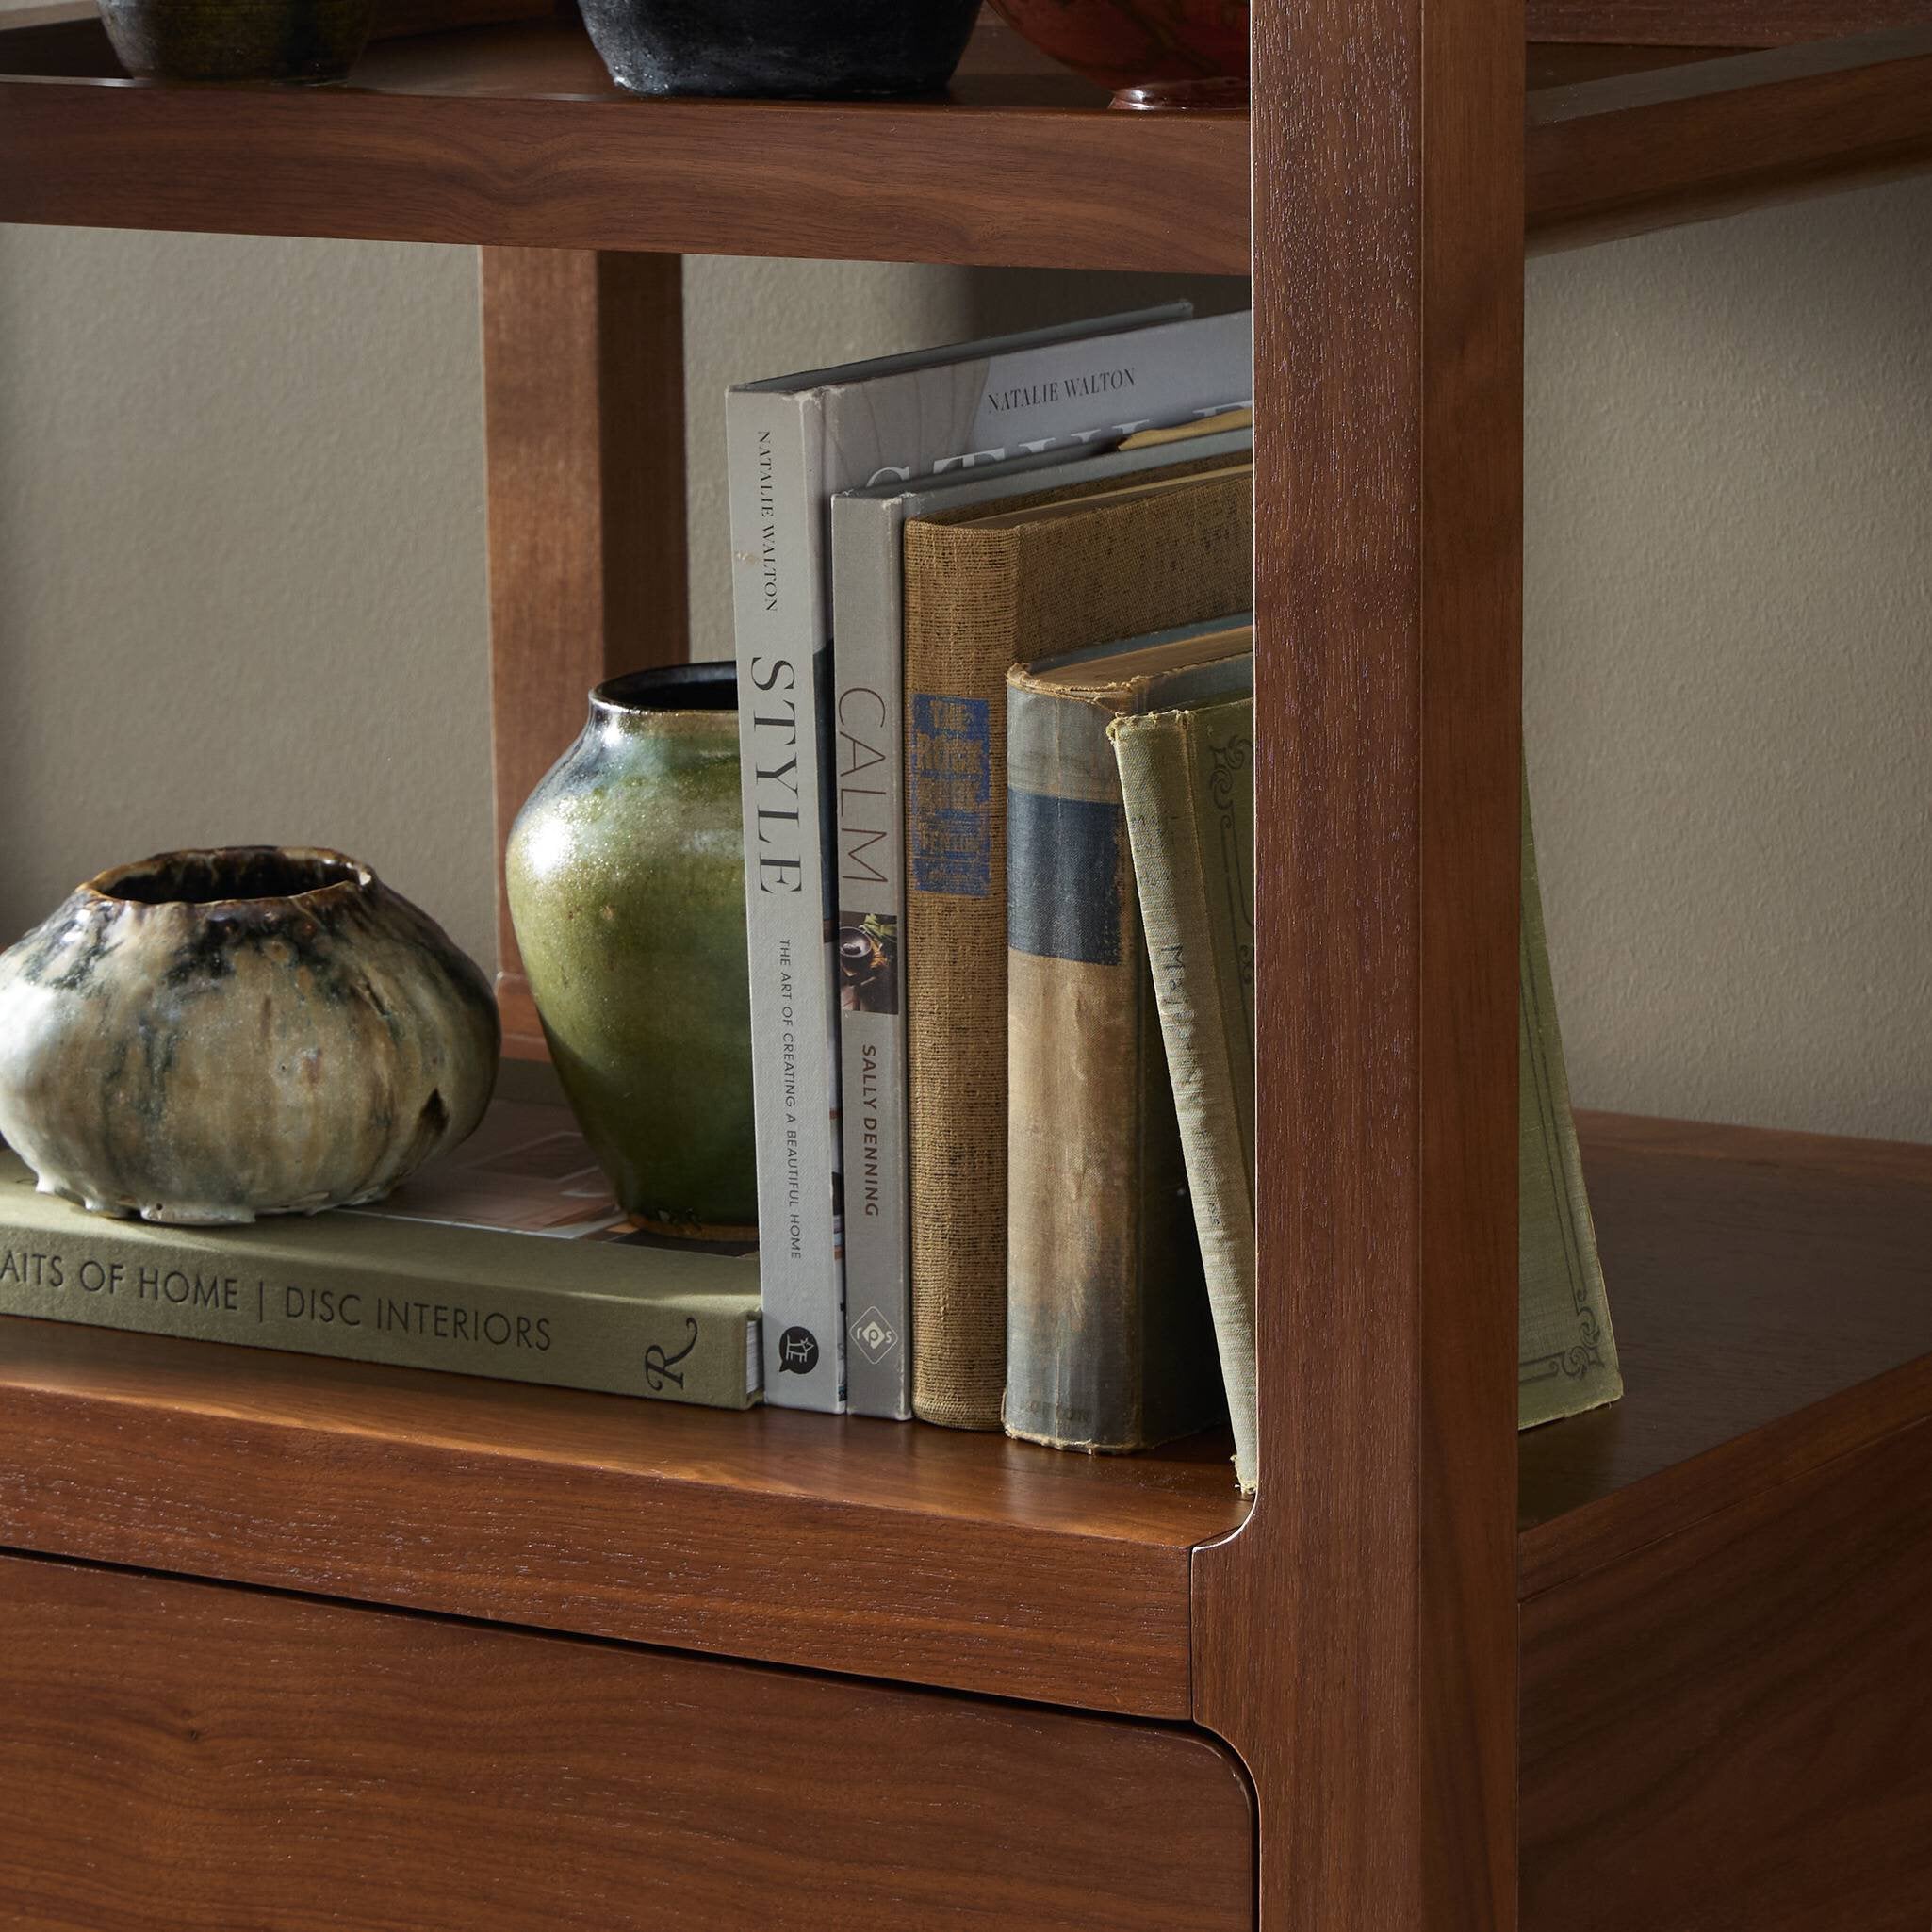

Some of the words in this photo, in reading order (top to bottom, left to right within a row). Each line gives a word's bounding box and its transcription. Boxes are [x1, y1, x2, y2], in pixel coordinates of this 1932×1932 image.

[987, 381, 1059, 413] NATALIE
[1064, 368, 1136, 398] WALTON
[758, 431, 775, 517] NATALIE
[762, 524, 778, 613] WALTON
[750, 656, 802, 894] STYLE
[838, 687, 889, 883] CALM
[779, 939, 791, 967] THE
[781, 972, 793, 1000] ART
[782, 1006, 794, 1027] OF
[782, 1032, 796, 1107] CREATING
[861, 1044, 877, 1111] SALLY
[786, 1113, 796, 1124] A
[787, 1130, 800, 1207] BEAUTIFUL
[863, 1117, 879, 1217] DENNING
[790, 1214, 801, 1259] HOME
[0, 1250, 64, 1287] AITS
[79, 1261, 124, 1295] OF
[139, 1268, 238, 1311] HOME
[286, 1286, 362, 1325] DISC
[377, 1298, 552, 1351] INTERIORS
